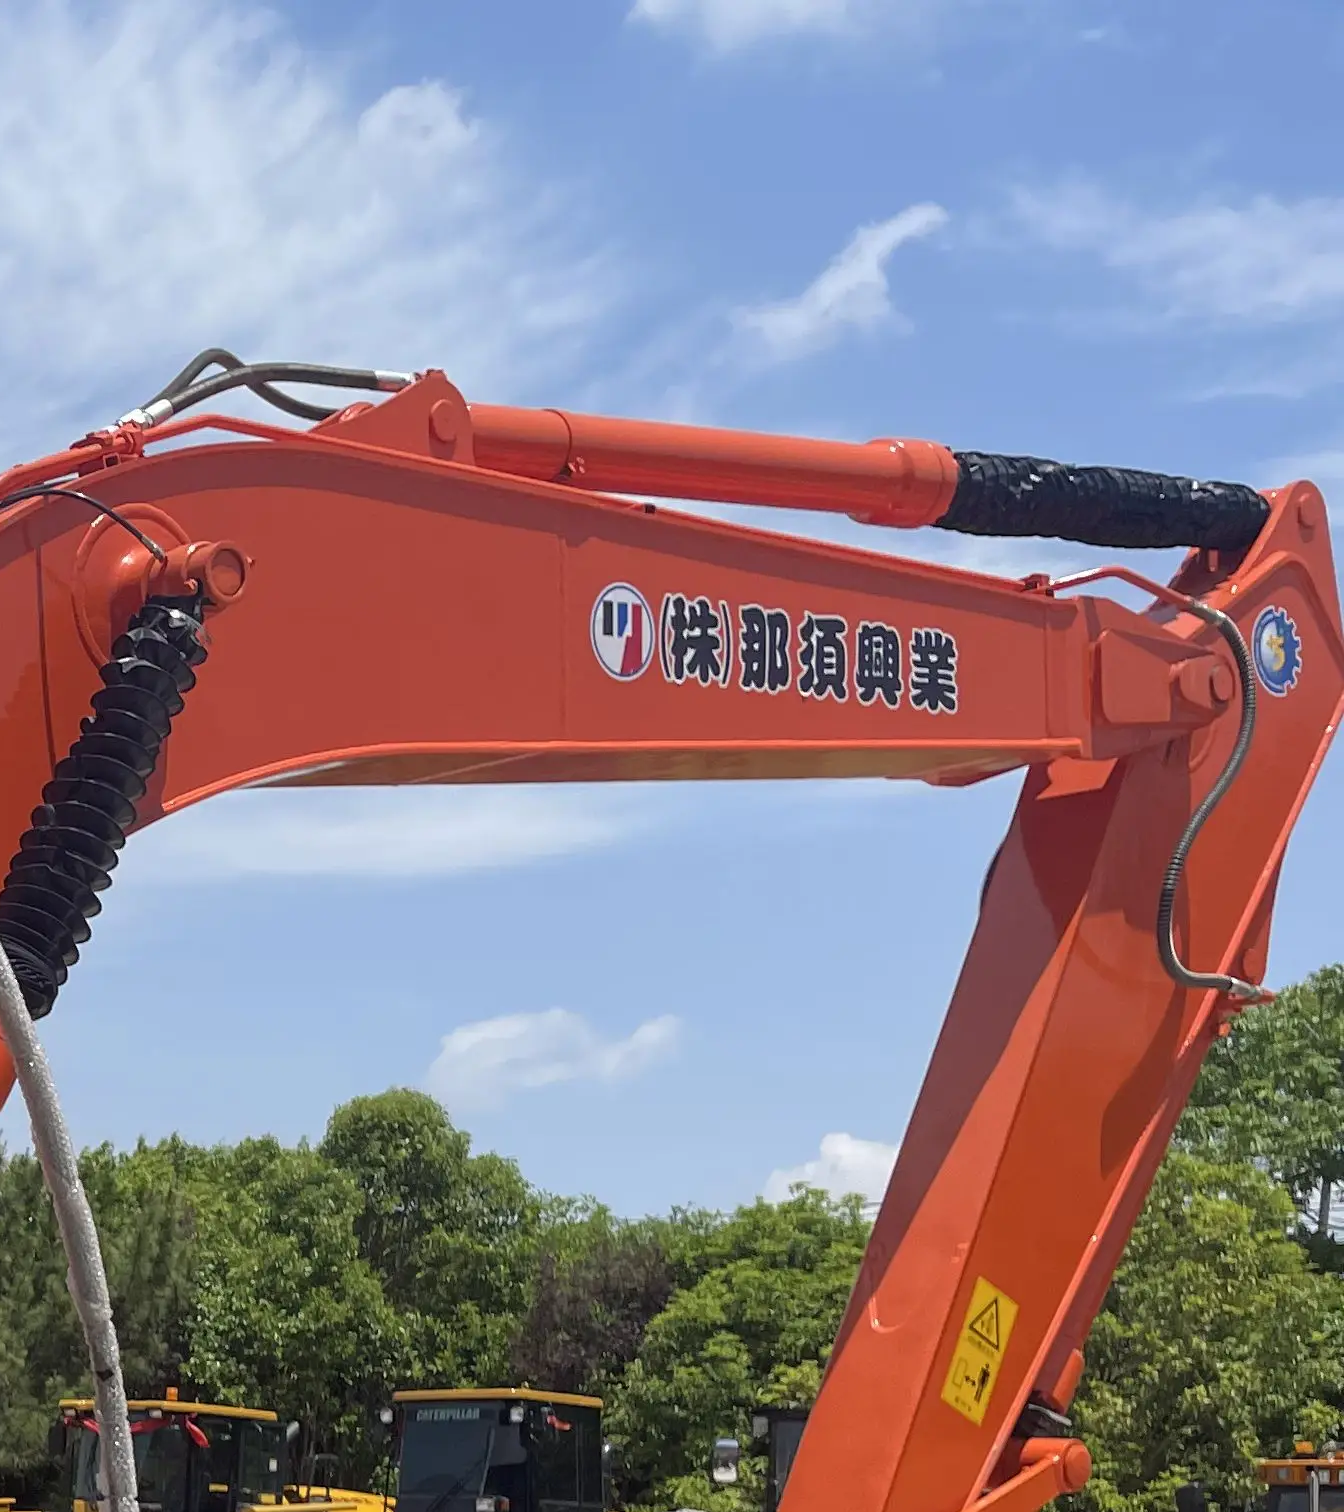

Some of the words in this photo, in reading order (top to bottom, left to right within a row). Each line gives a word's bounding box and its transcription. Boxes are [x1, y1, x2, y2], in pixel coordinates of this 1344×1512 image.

[659, 594, 957, 713] (株)那須興業
